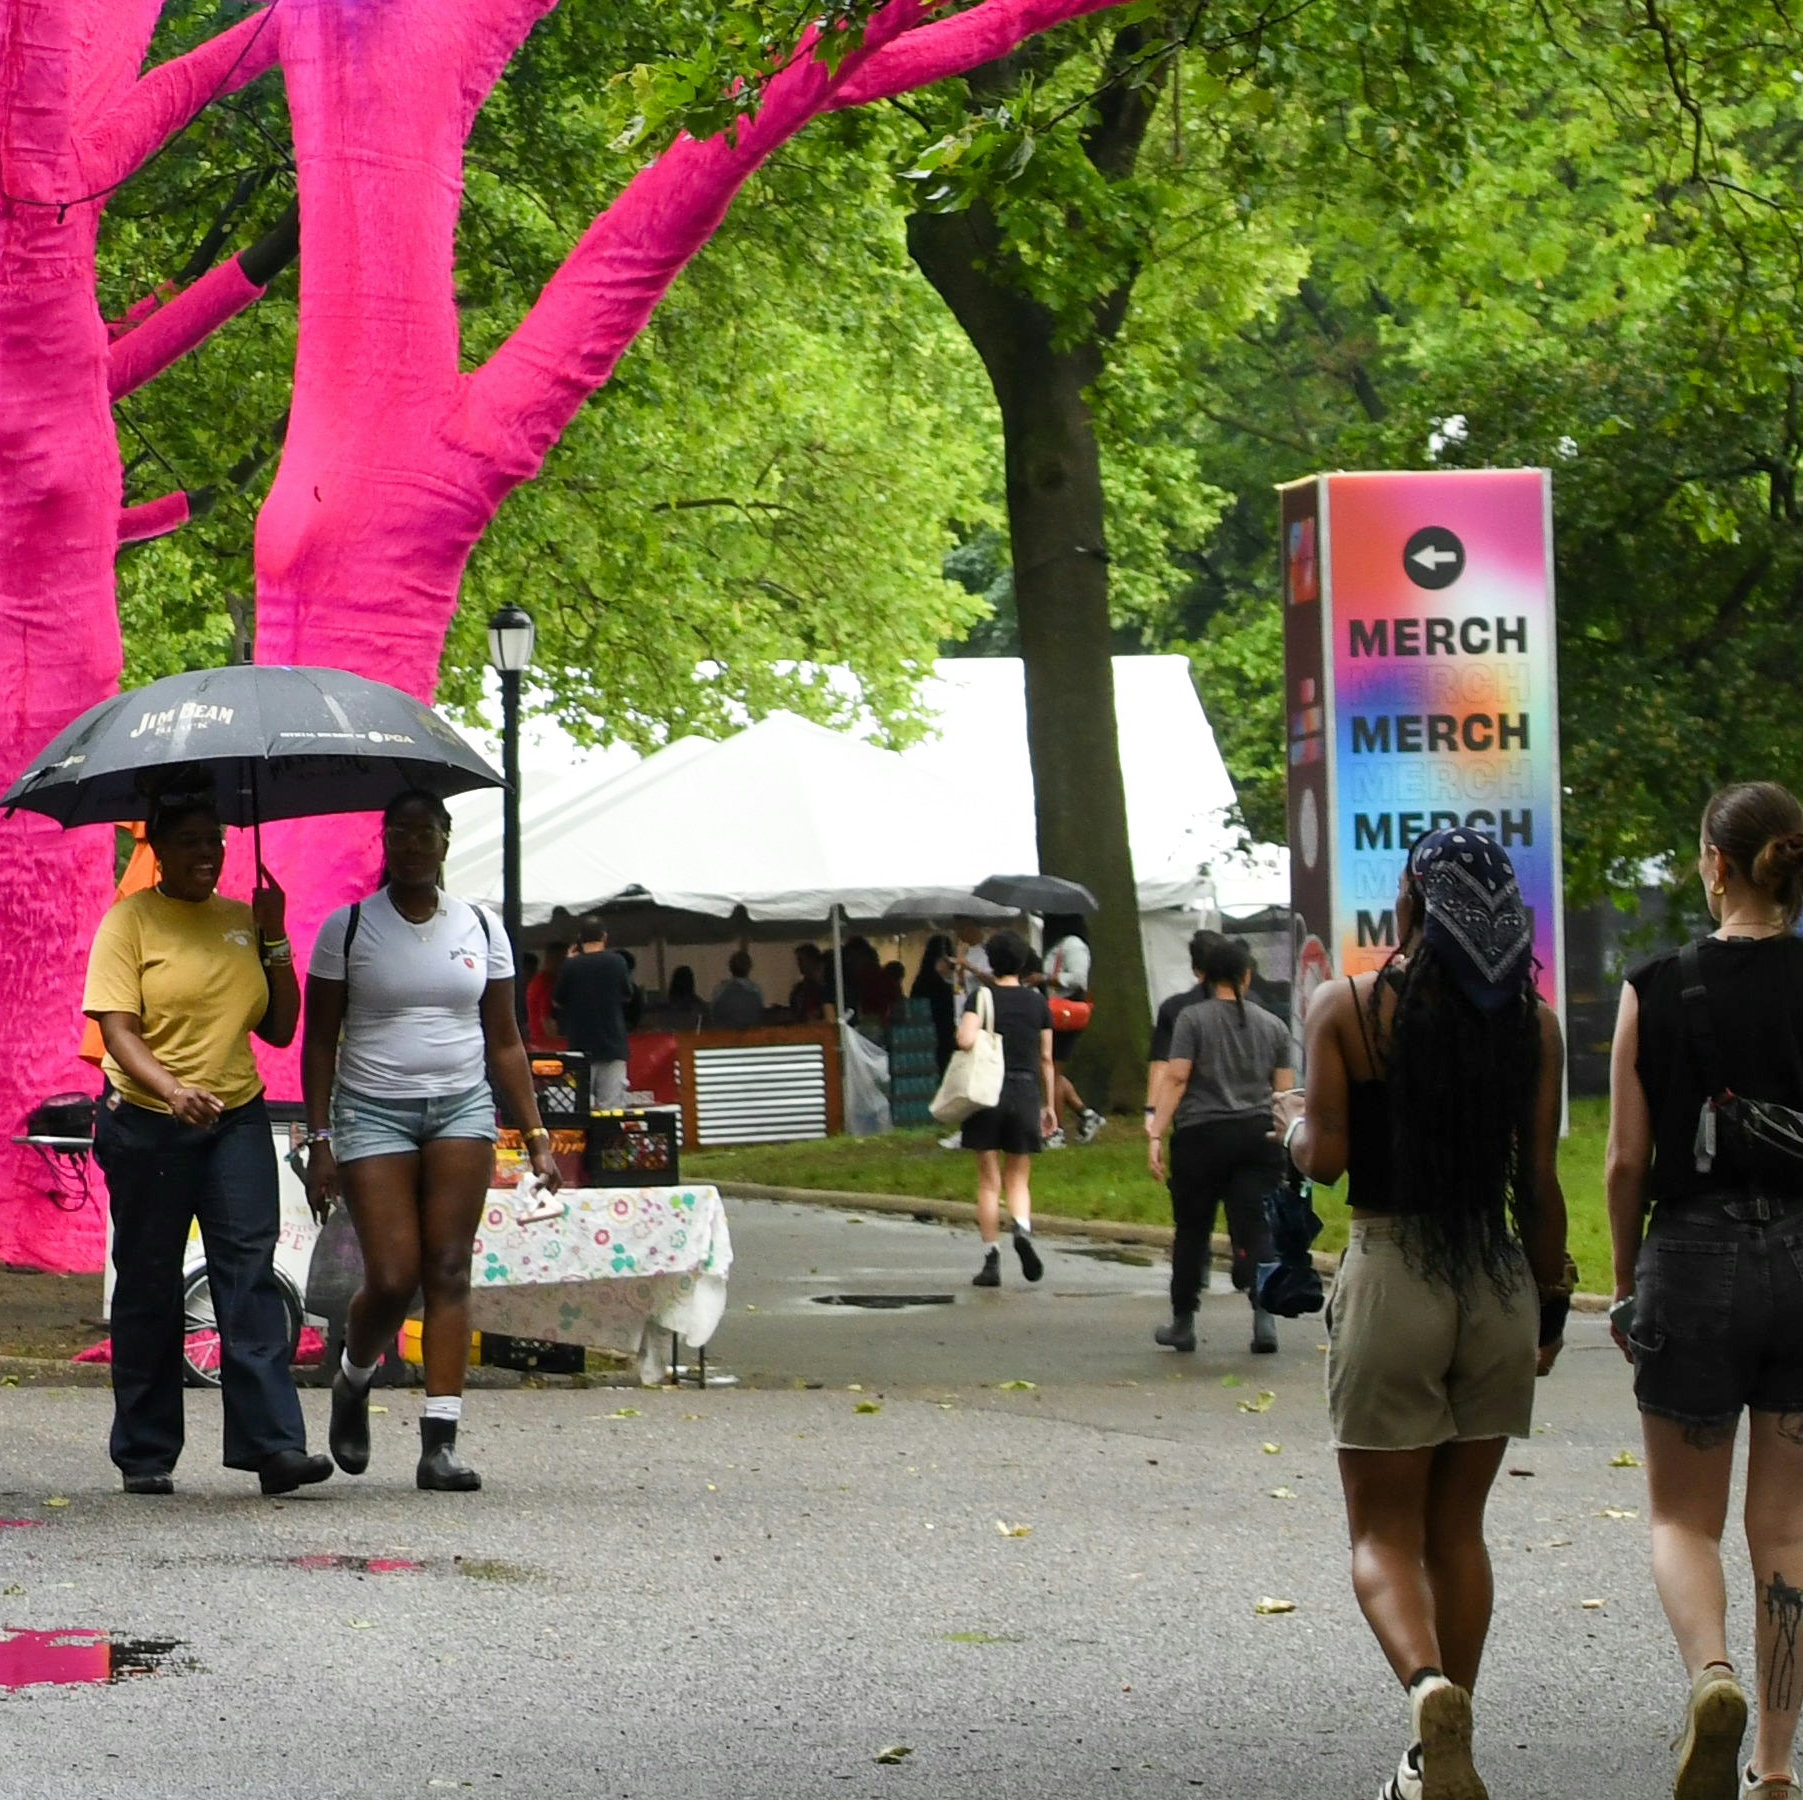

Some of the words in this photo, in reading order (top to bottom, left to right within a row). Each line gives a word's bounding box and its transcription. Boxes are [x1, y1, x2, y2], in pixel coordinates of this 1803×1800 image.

[1349, 616, 1528, 658] MERCH
[1349, 663, 1532, 707] MERCH
[130, 709, 176, 739] JIM
[178, 701, 235, 726] BEAM
[1352, 712, 1531, 754] MERCH
[1352, 759, 1535, 804] MERCH
